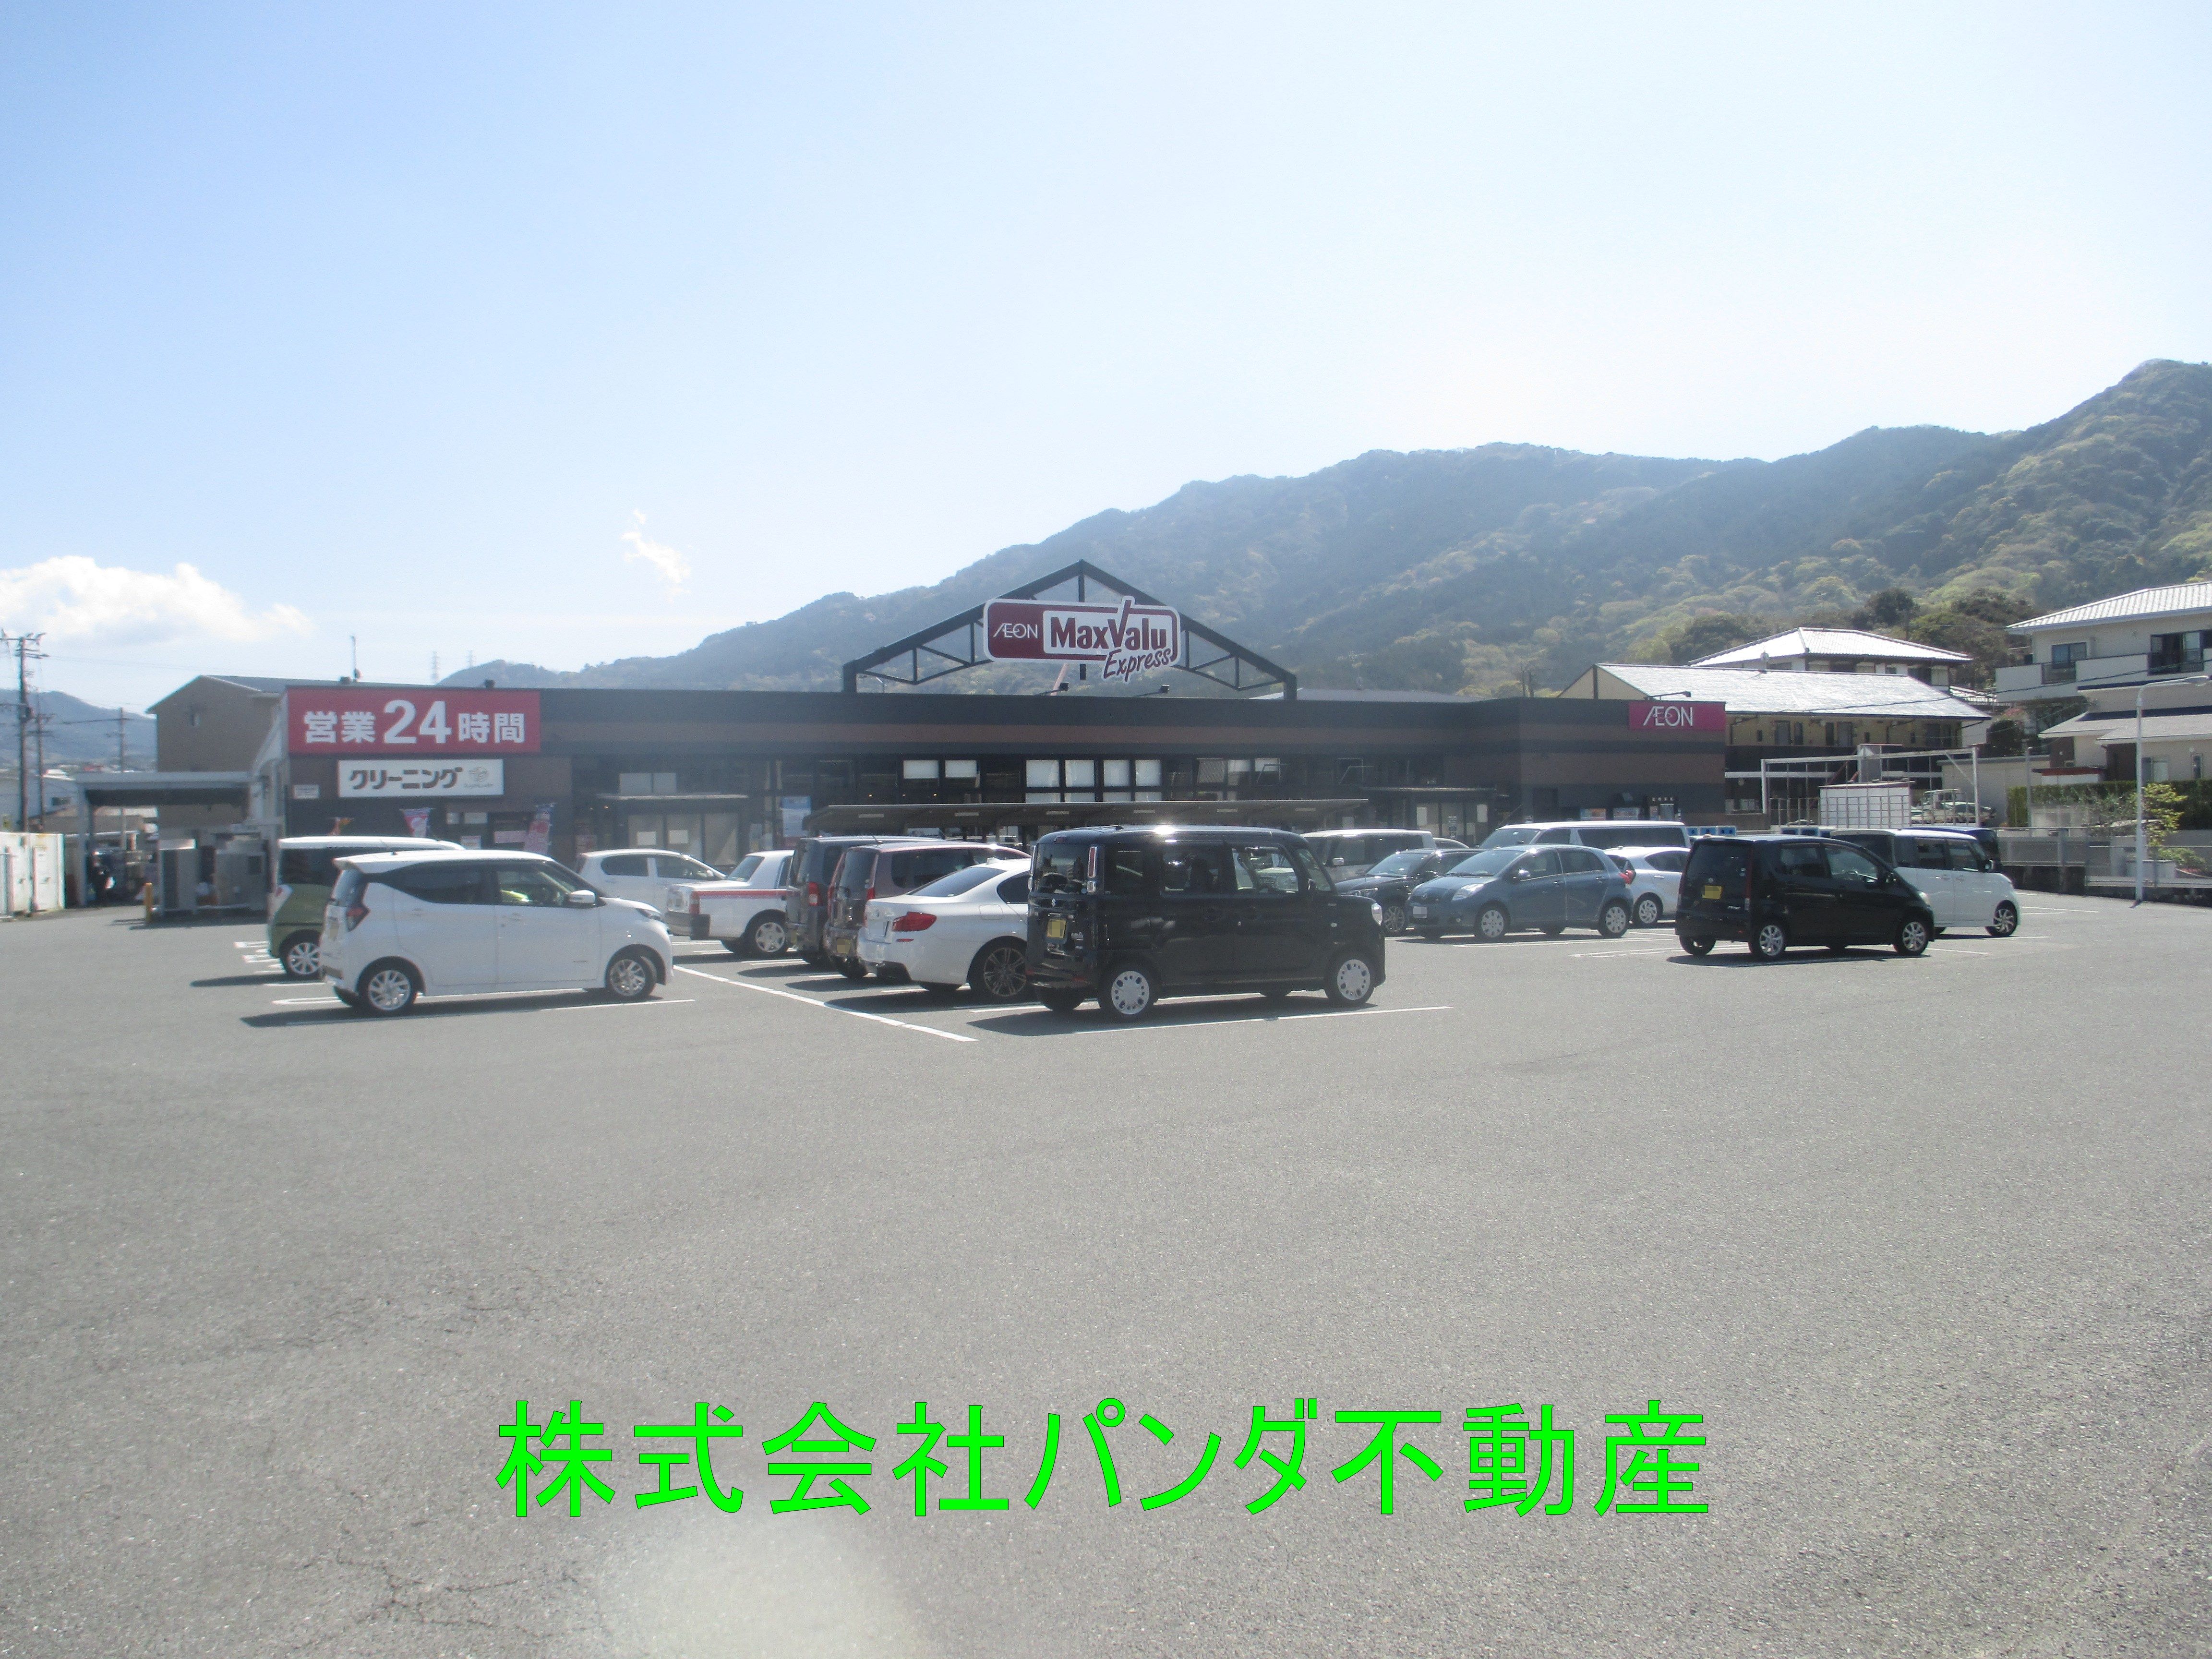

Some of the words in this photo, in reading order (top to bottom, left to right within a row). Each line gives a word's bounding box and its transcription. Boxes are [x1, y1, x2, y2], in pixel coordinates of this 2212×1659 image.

[1050, 600, 1167, 651] MaxValu
[1104, 648, 1172, 683] Express
[304, 699, 526, 745] 営業24時間
[350, 767, 463, 790] クリーニング
